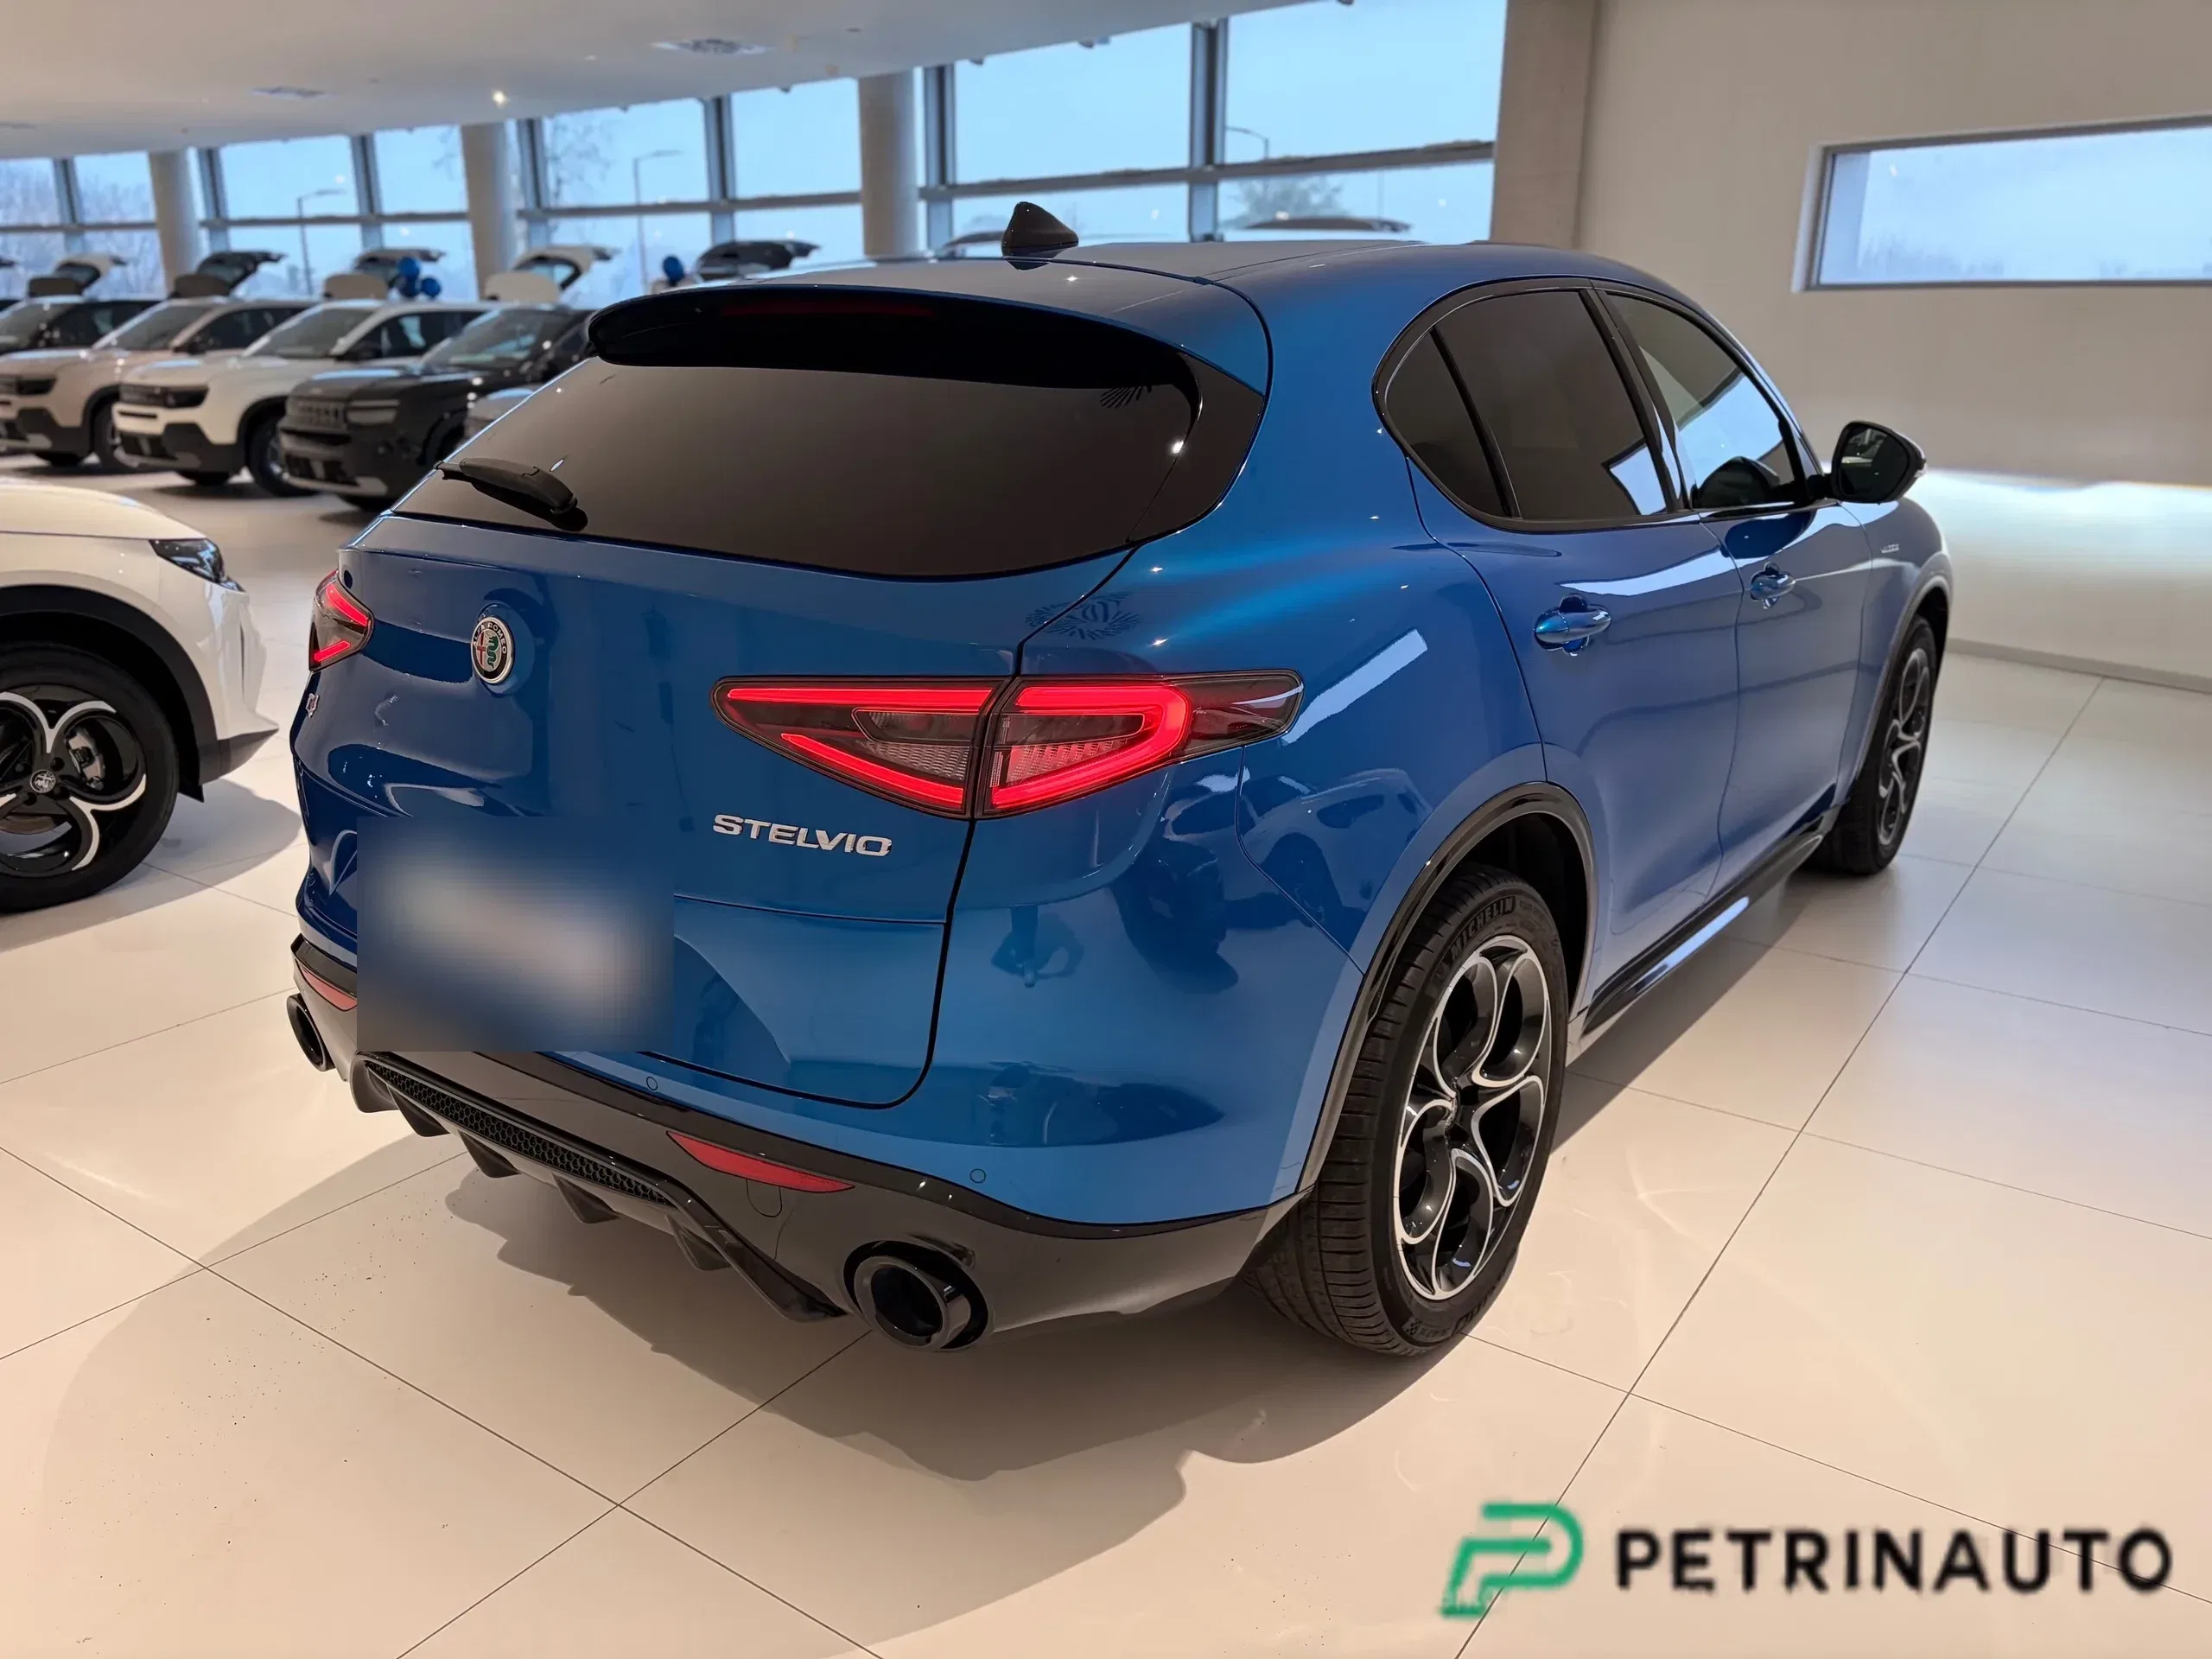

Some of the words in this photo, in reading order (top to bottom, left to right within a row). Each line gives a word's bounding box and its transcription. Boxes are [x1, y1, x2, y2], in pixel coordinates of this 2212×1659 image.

[487, 621, 507, 654] ROMEO
[713, 814, 893, 856] STELVIO
[1450, 896, 1516, 962] MICHELIN
